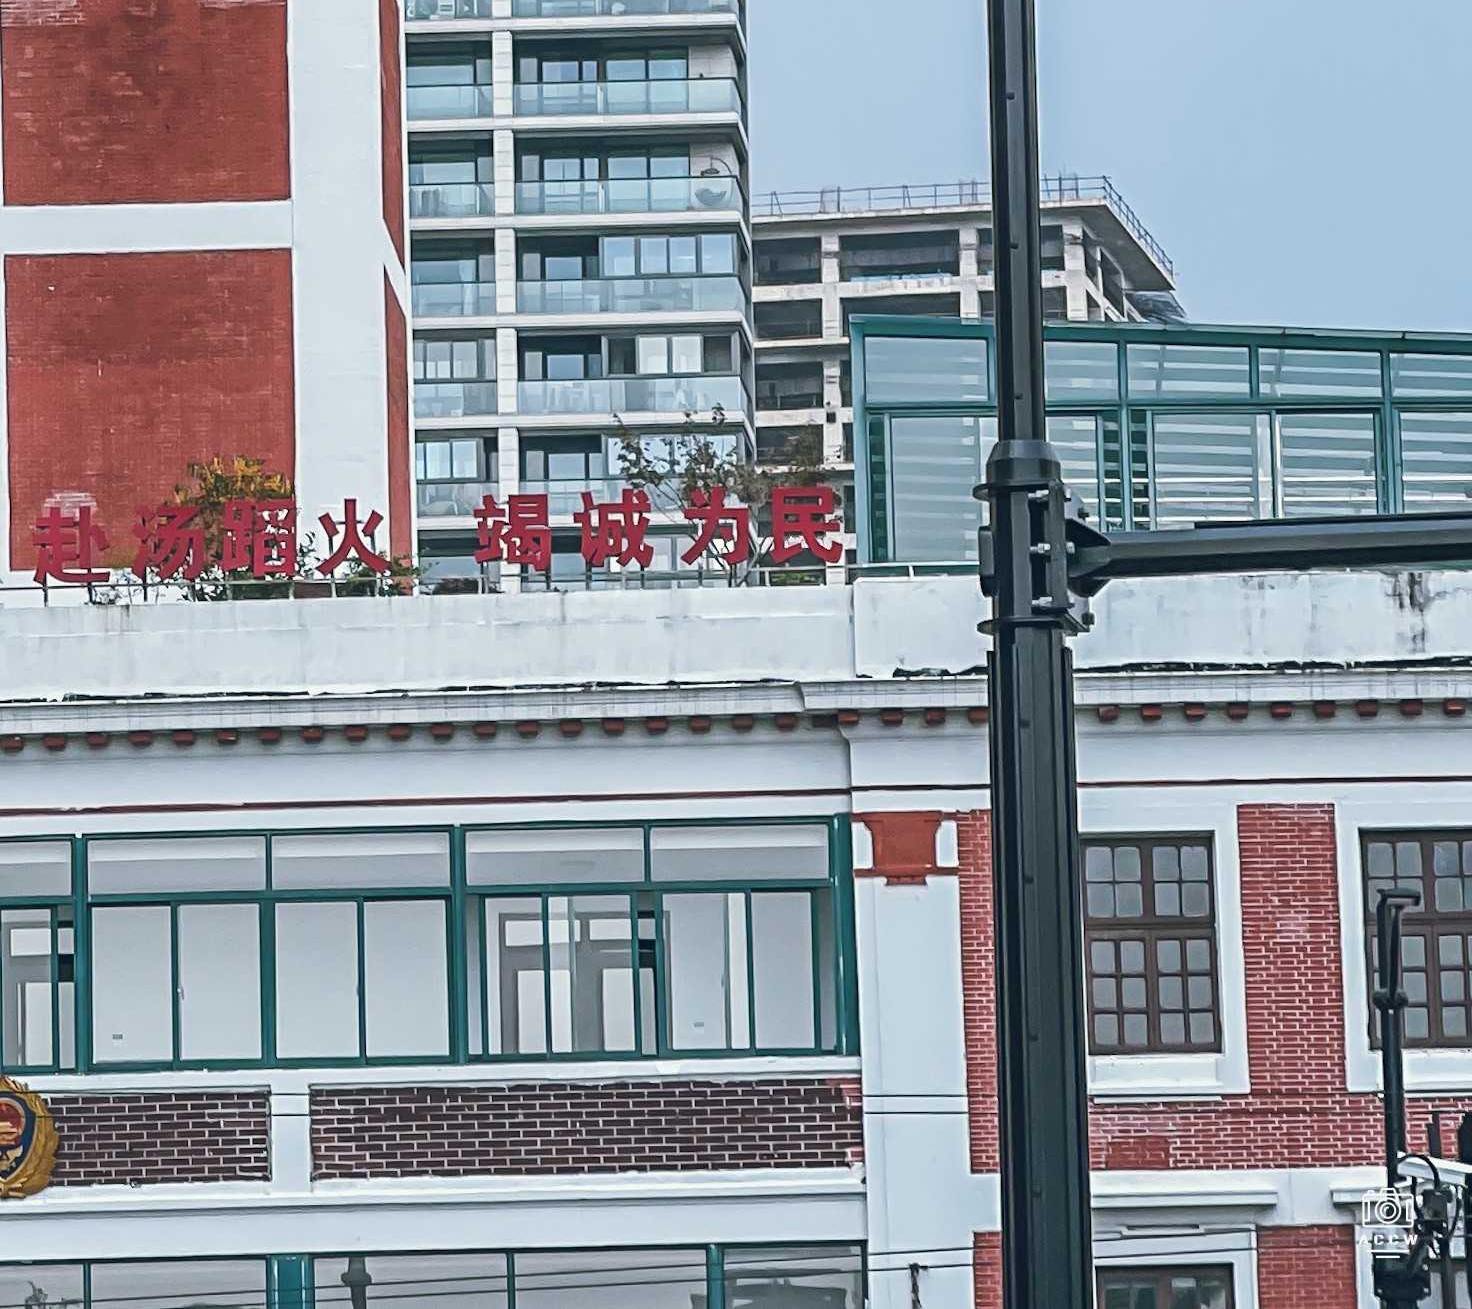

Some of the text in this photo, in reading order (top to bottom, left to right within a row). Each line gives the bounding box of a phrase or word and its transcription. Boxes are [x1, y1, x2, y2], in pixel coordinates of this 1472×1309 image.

[31, 498, 392, 584] 赴汤蹈火
[473, 485, 844, 573] 竭诚为民
